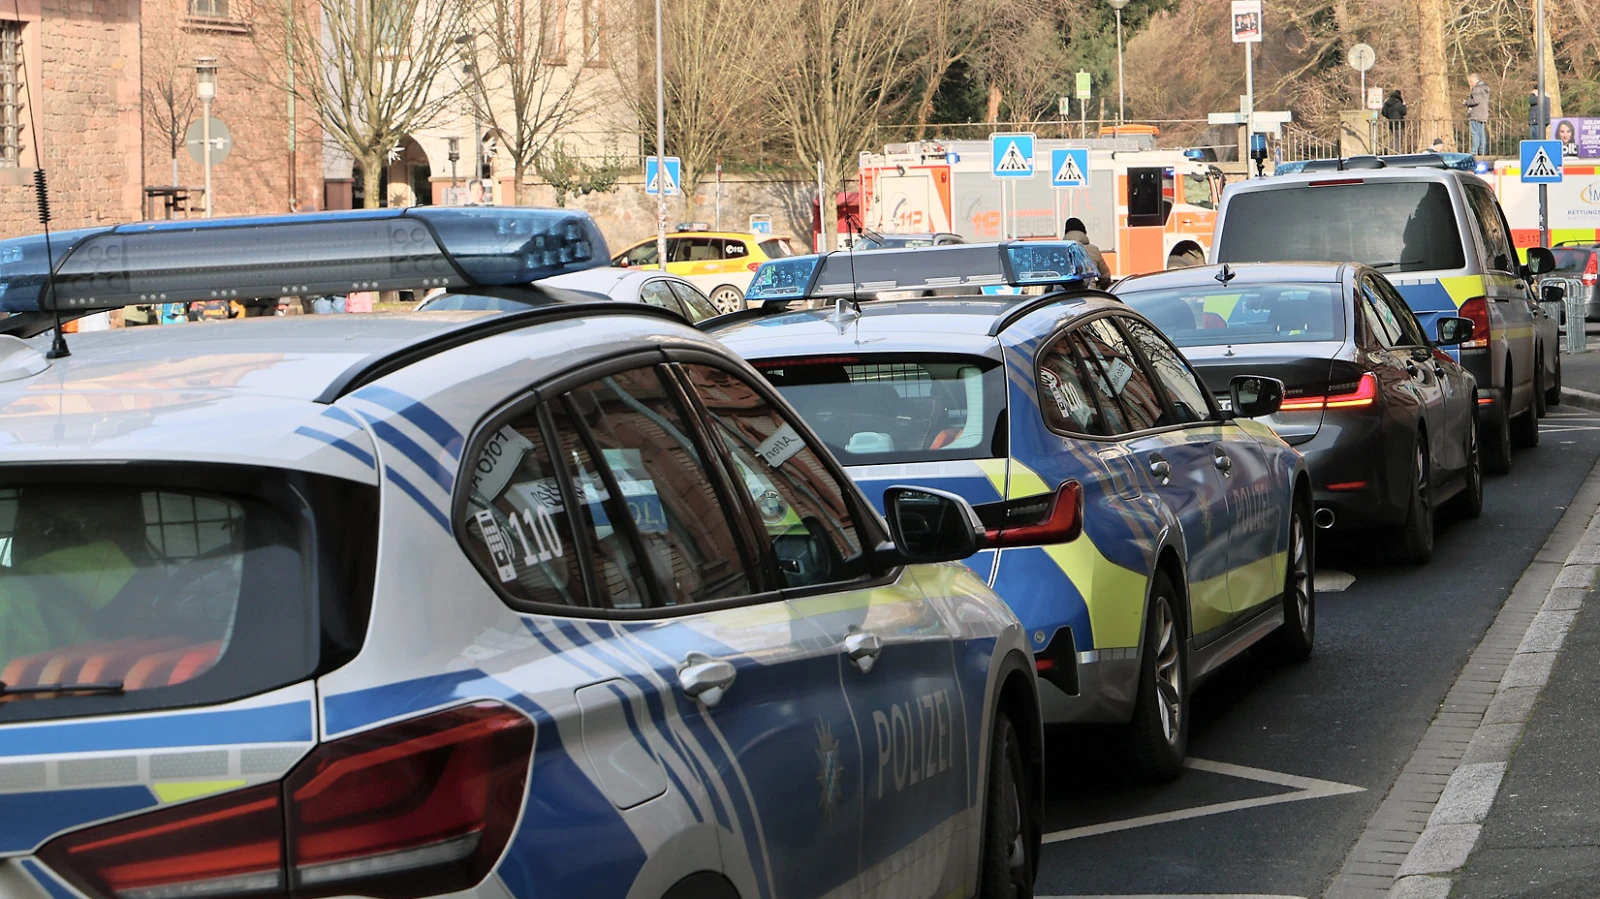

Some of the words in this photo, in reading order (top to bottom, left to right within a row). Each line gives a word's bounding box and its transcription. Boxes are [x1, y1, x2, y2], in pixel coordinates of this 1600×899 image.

[1563, 143, 1578, 154] olt
[899, 210, 923, 233] 112
[1232, 483, 1271, 533] POLIZEI
[508, 505, 564, 567] 110
[872, 688, 953, 800] POLIZEI
